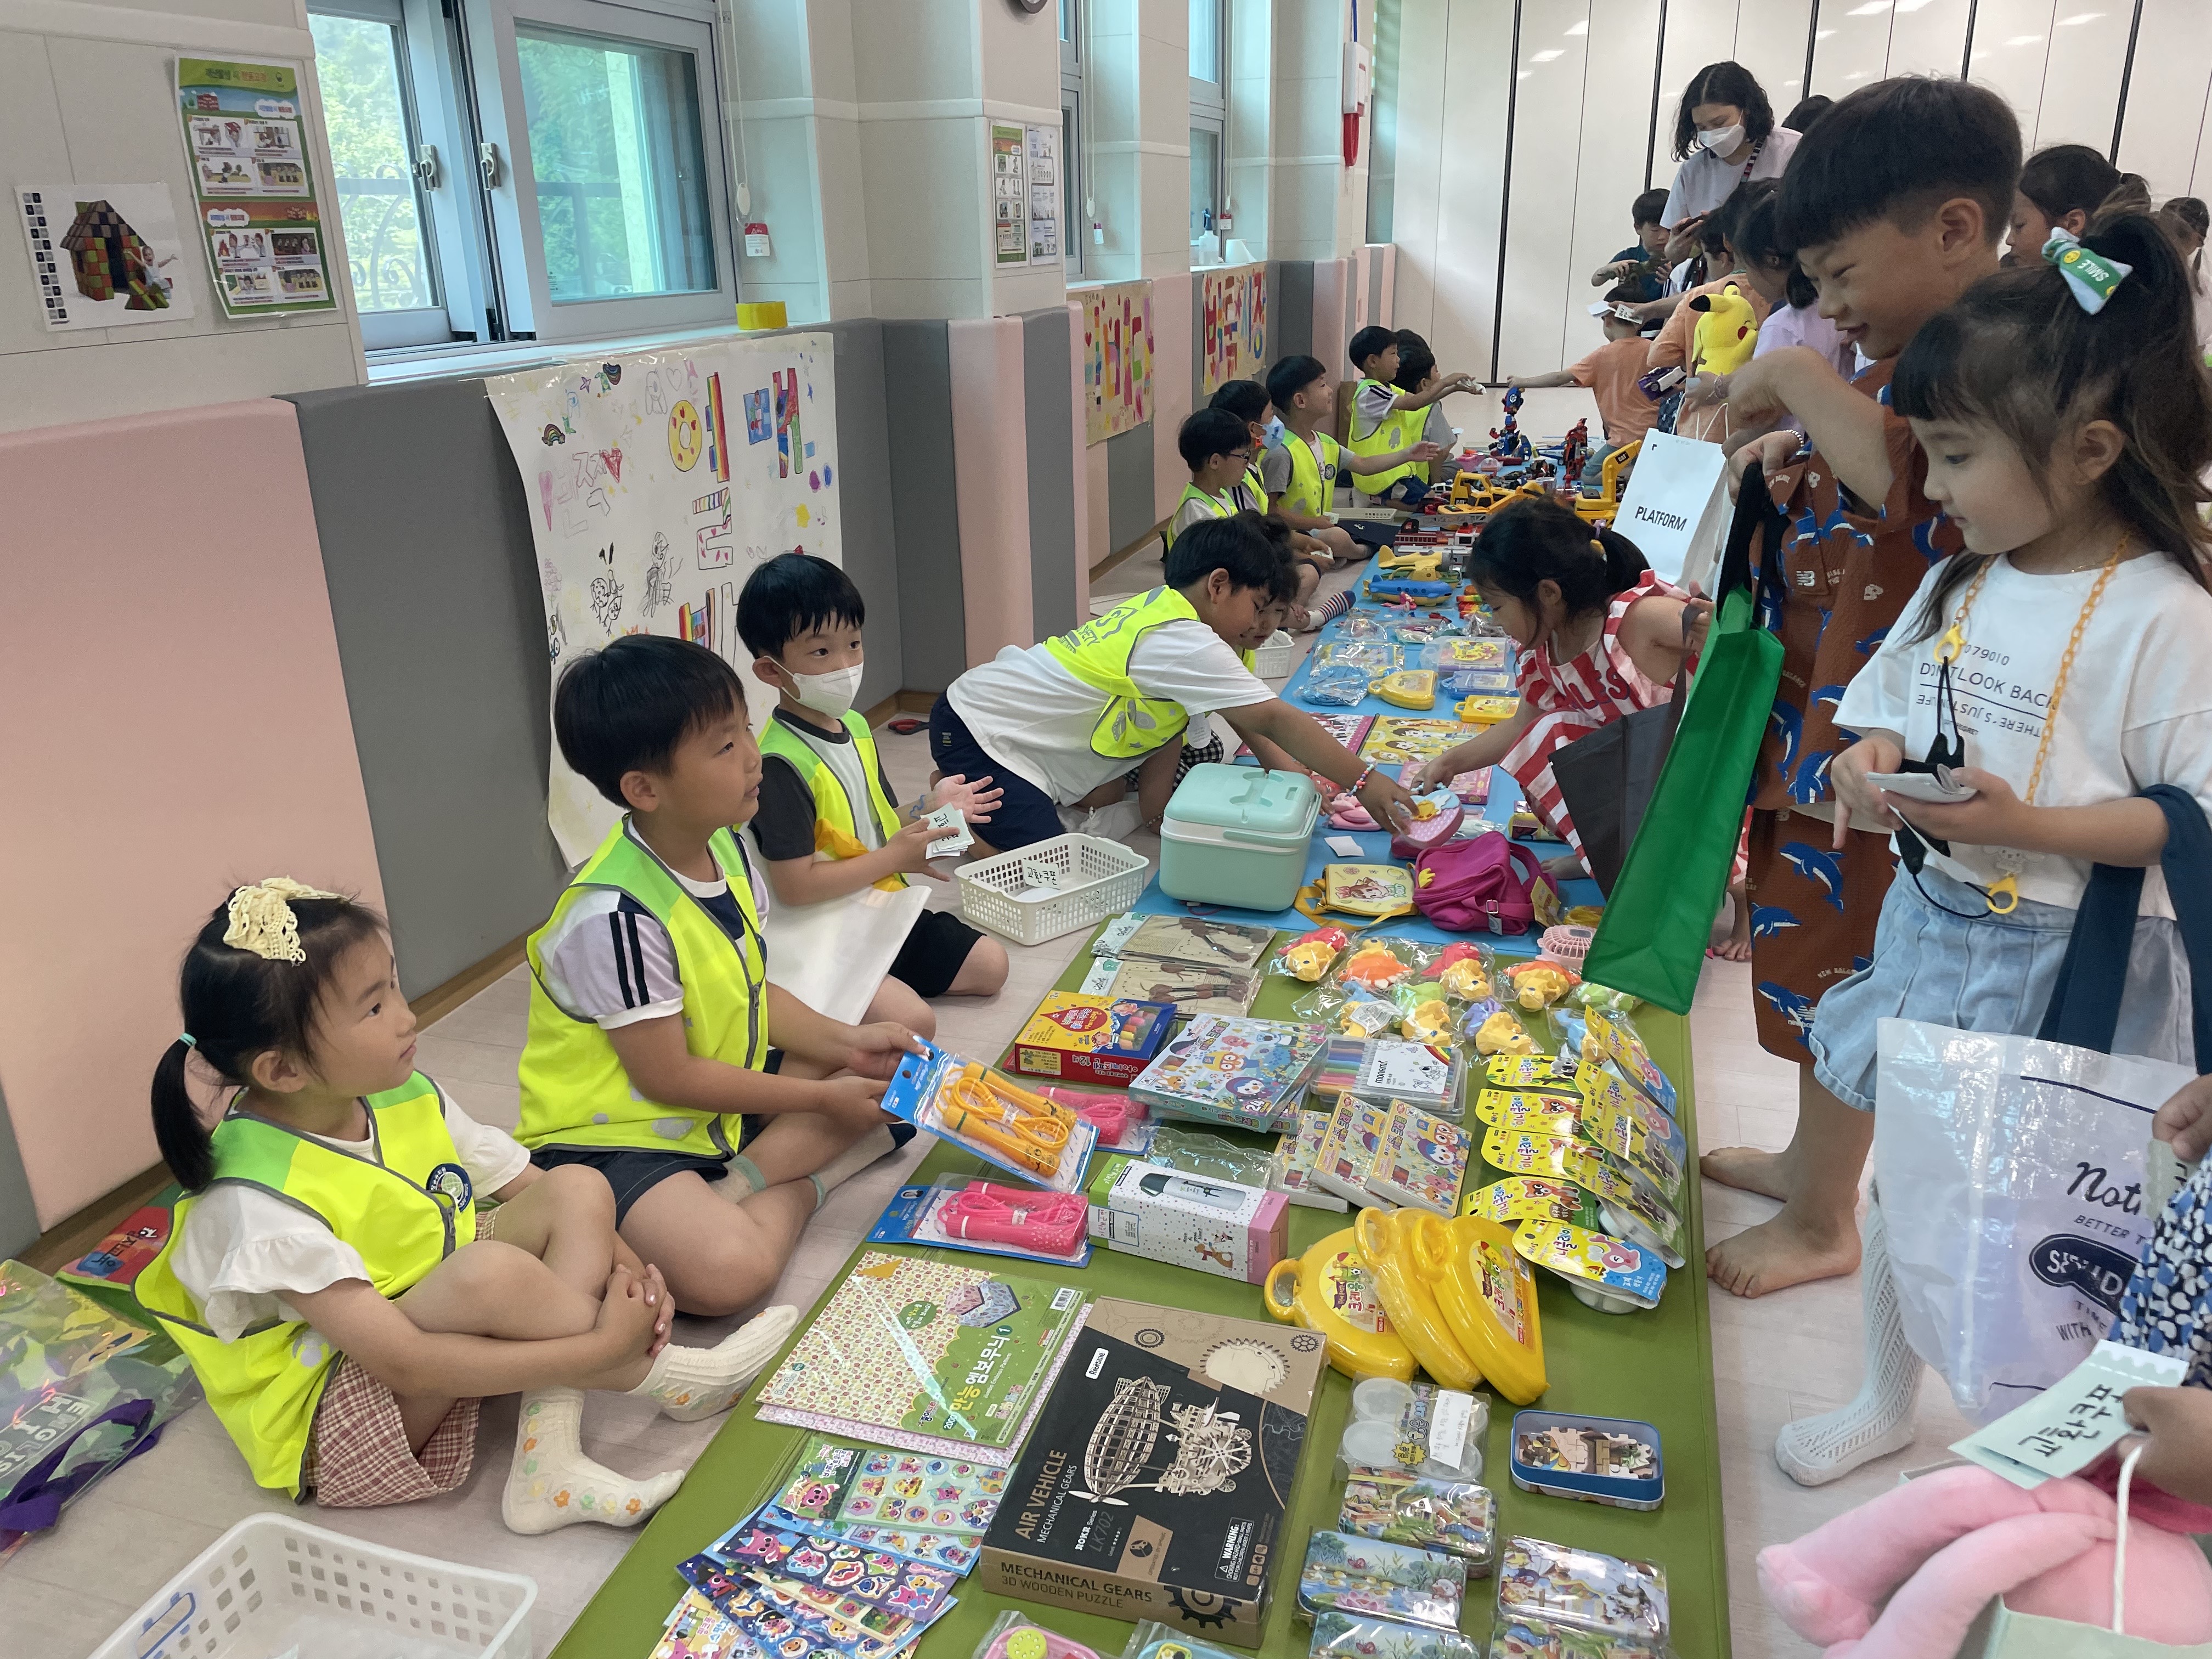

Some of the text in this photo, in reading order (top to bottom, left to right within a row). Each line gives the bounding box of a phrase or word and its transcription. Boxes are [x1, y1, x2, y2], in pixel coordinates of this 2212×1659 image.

[2076, 259, 2108, 281] SMILE
[1635, 506, 1688, 531] PLATFORM
[1027, 866, 1057, 886] 교환쿠폰
[1072, 1054, 1091, 1066] 12색
[1375, 1060, 1388, 1084] monami
[1518, 1057, 1539, 1082] 미니클레이
[1244, 1097, 1260, 1113] 24
[1509, 1095, 1531, 1125] 미니클레이
[1517, 1135, 1539, 1169] 미니클레이
[1492, 1183, 1514, 1217] 미니클레이
[2074, 1214, 2130, 1239] BETTER
[1347, 1282, 1366, 1312] 크레용
[1490, 1278, 1506, 1312] 크레용
[2056, 1321, 2092, 1341] WITH
[944, 1414, 958, 1430] 2000
[1015, 1450, 1067, 1539] AIR VEHICLE
[1037, 1464, 1077, 1543] MECHANICAL GEARS
[1075, 1510, 1097, 1551] ROKR Series
[1089, 1511, 1114, 1552] LK702
[1222, 1525, 1240, 1559] WARNING:
[1001, 1561, 1152, 1602] MECHANICAL GEARS
[1001, 1575, 1124, 1609] 3D WOODEN PUZZLE
